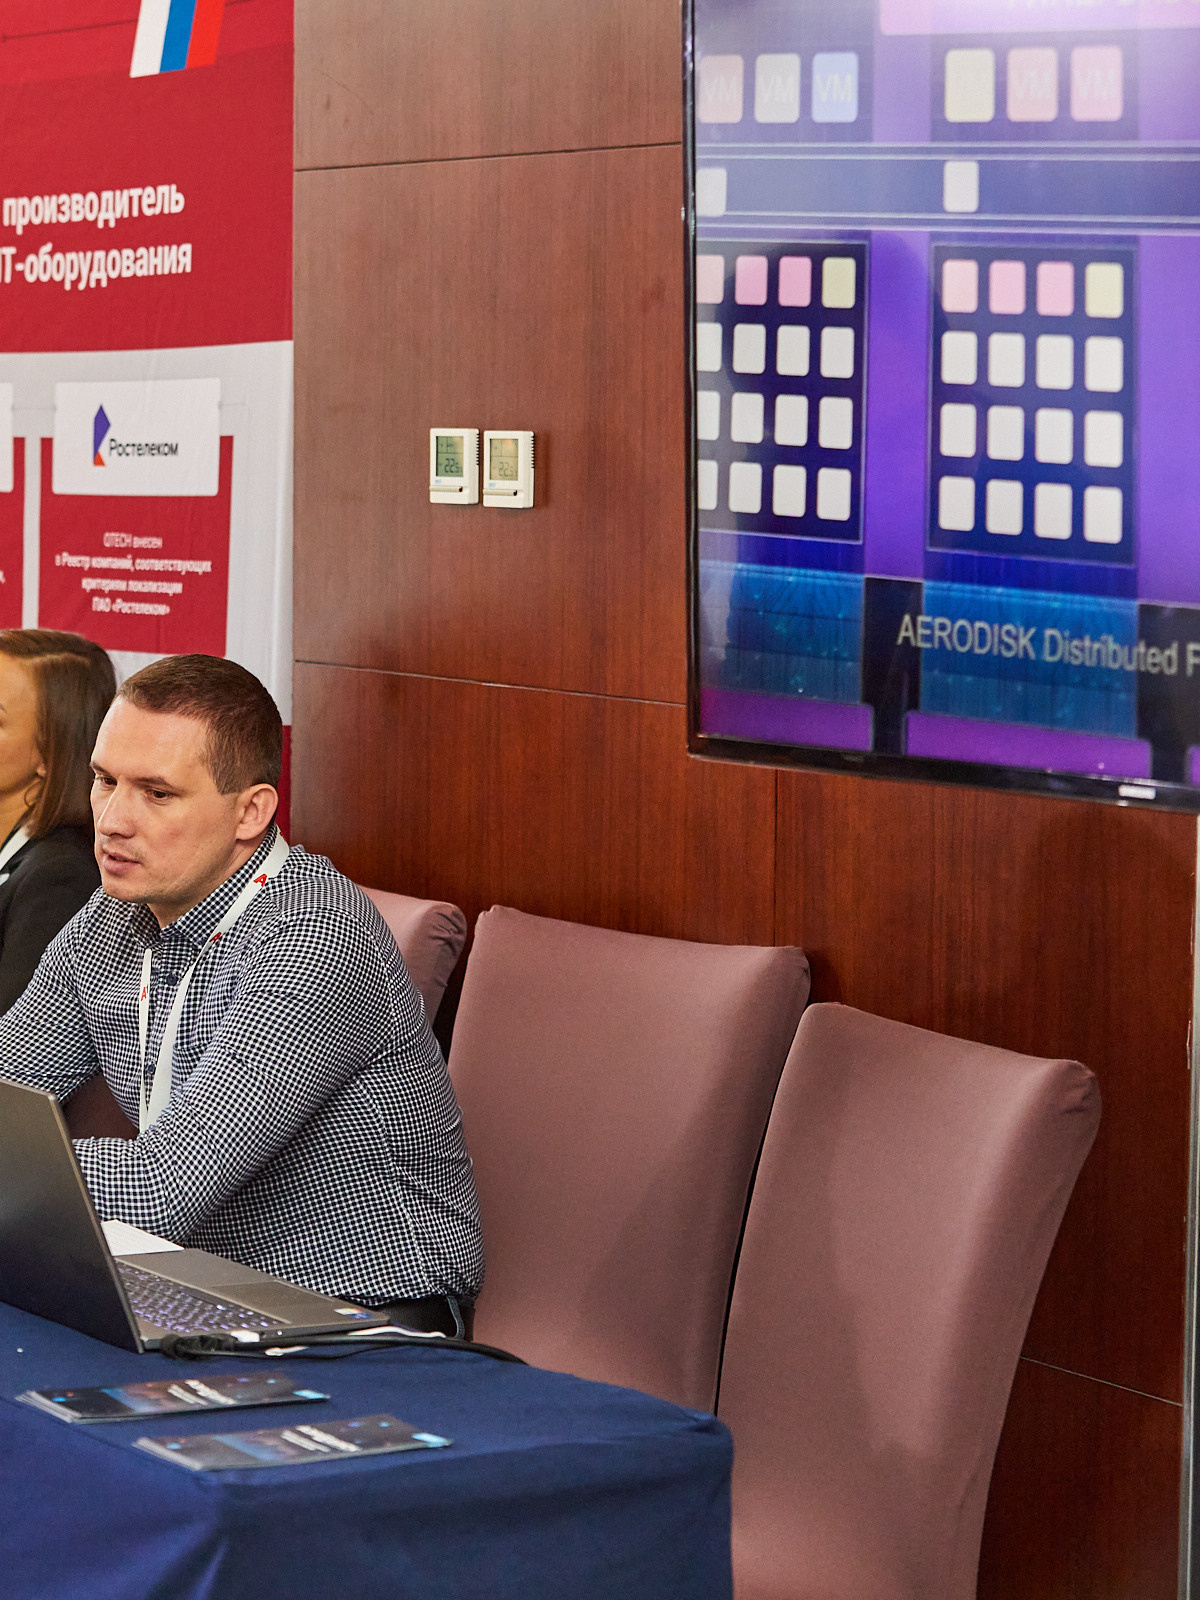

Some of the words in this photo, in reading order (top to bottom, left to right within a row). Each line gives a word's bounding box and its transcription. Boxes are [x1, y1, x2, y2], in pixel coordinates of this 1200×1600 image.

[815, 73, 853, 102] VM
[3, 184, 185, 235] производитель
[109, 438, 179, 456] Ростелеком
[103, 532, 132, 547] QTECH
[897, 614, 1037, 660] AERODISK
[1042, 628, 1179, 676] Distributed
